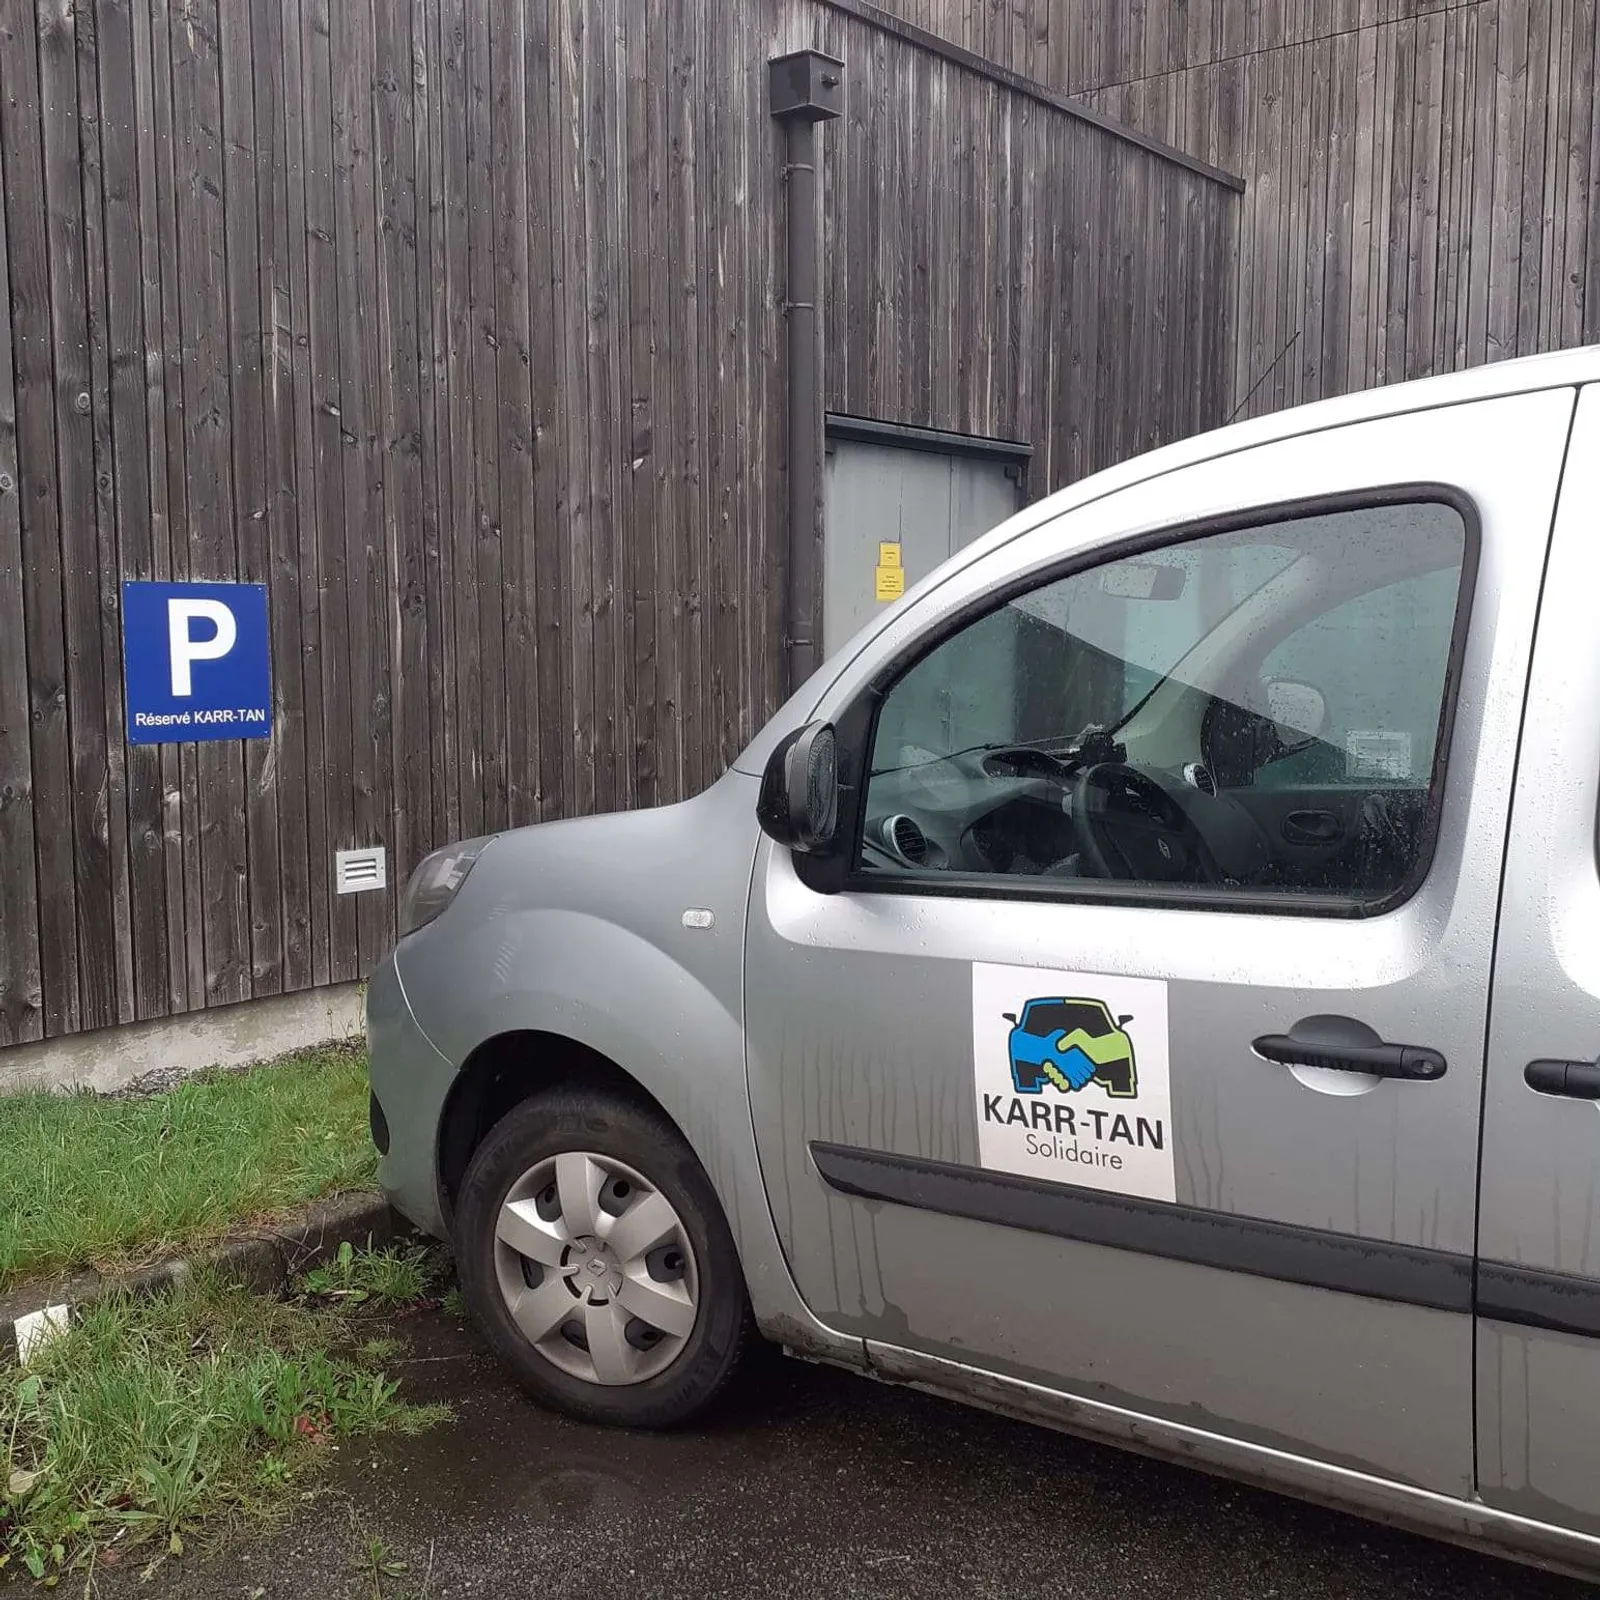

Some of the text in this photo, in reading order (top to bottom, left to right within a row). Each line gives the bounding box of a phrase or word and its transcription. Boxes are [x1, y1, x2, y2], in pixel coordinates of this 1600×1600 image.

[168, 599, 236, 696] P
[135, 709, 265, 726] Réservé KARR-TAN
[984, 1093, 1164, 1150] KARR-TAN
[1026, 1133, 1123, 1170] Solidaire
